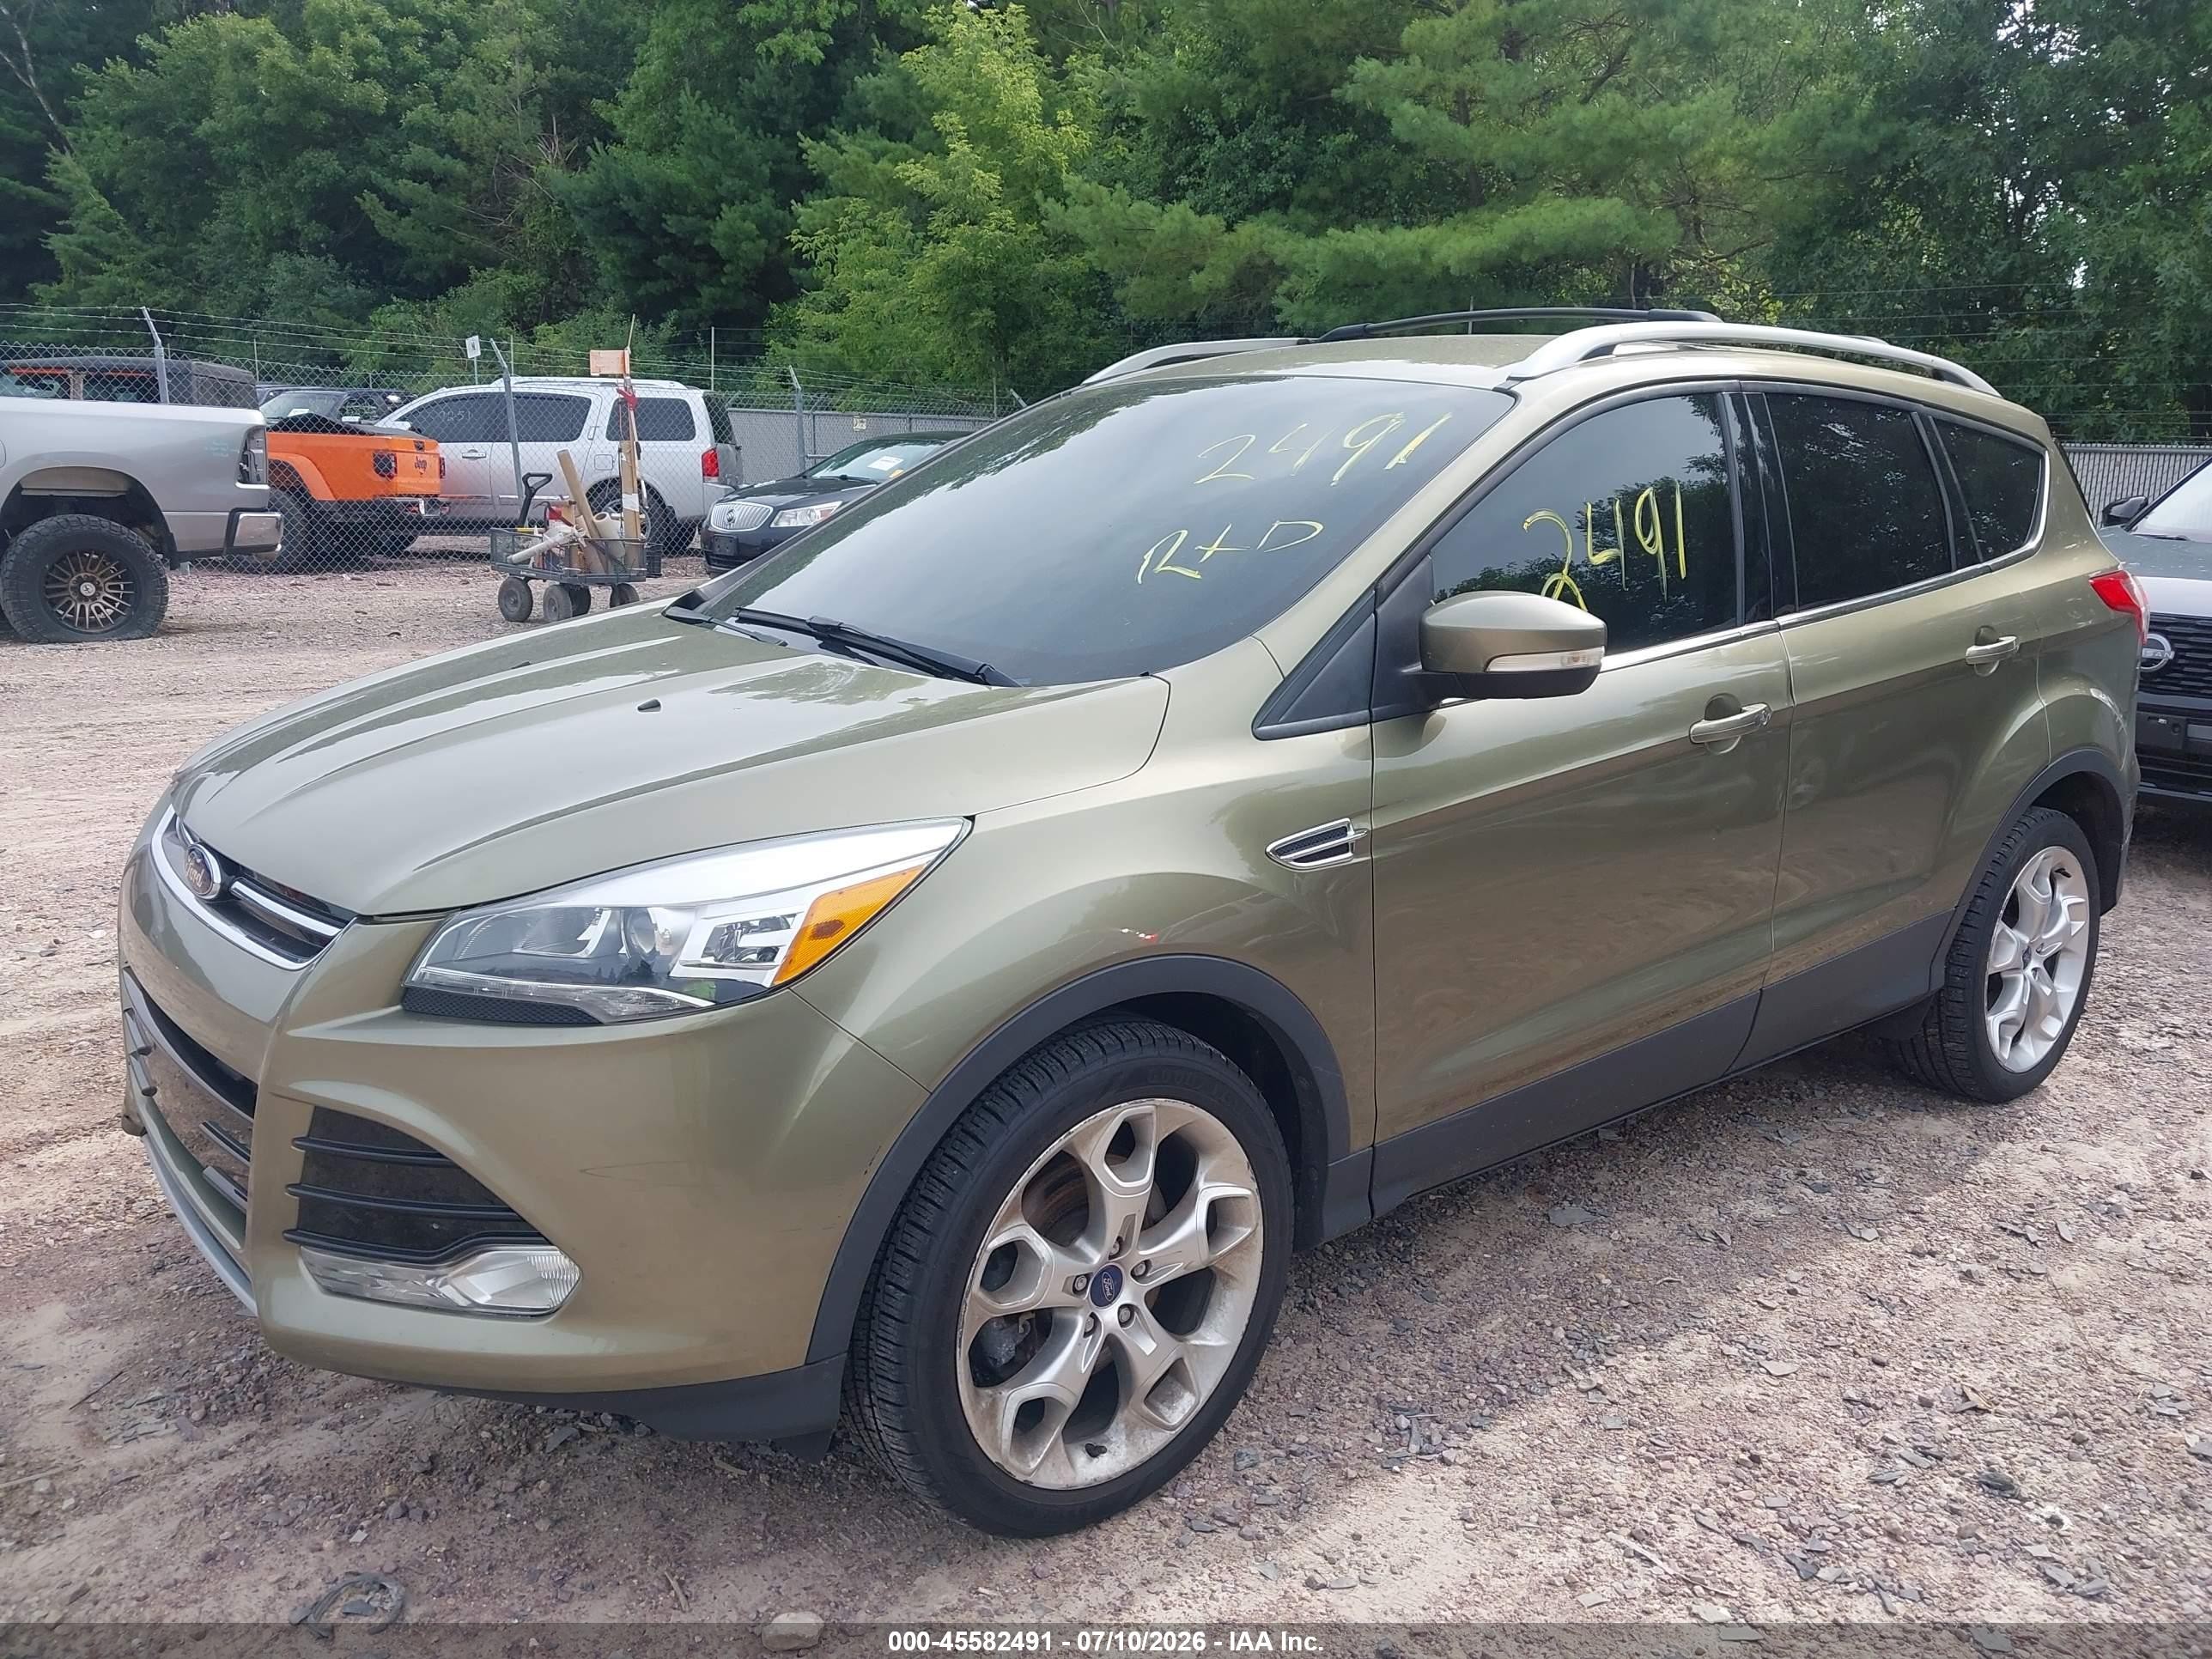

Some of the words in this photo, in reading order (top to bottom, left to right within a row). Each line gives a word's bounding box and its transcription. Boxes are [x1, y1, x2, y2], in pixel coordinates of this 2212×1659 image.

[1194, 411, 1452, 487] 2491
[1522, 478, 1687, 612] 2491
[2144, 649, 2175, 659] SAN
[185, 851, 205, 888] Ford
